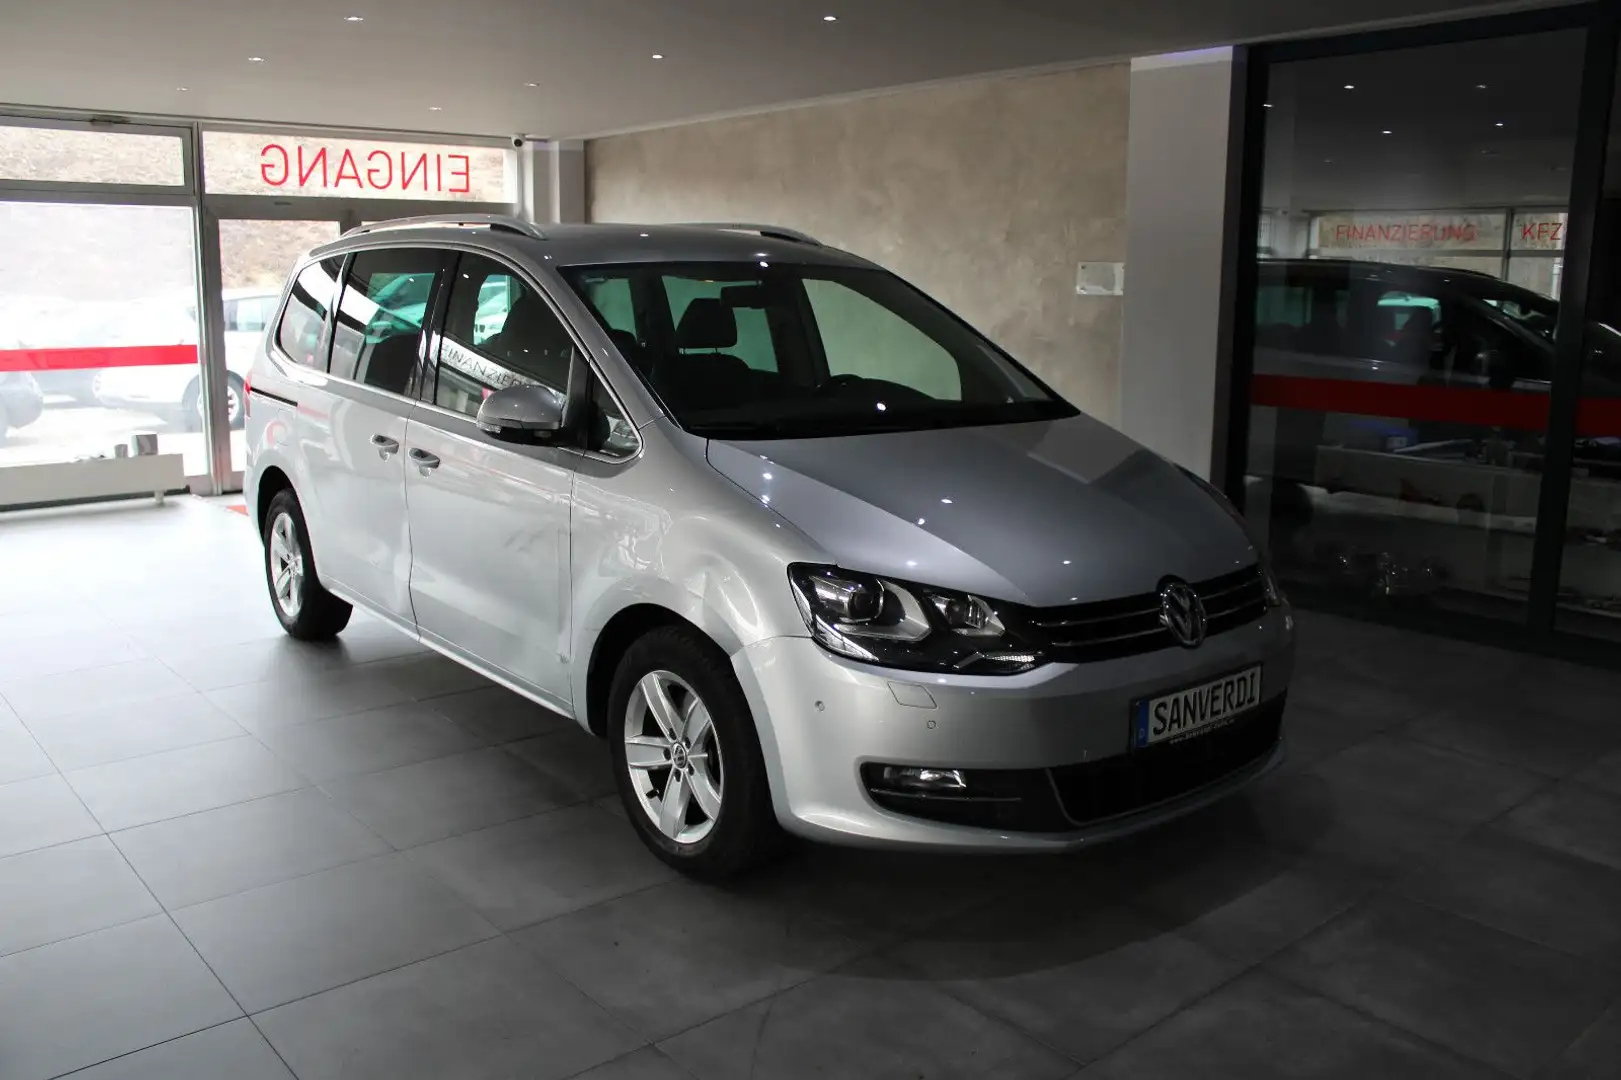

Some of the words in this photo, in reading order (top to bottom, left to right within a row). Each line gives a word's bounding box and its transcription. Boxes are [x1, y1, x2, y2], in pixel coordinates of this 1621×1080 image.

[1336, 223, 1477, 242] FINANZIERUNG
[1522, 222, 1563, 241] KFZ
[1153, 672, 1255, 736] SANVERDI
